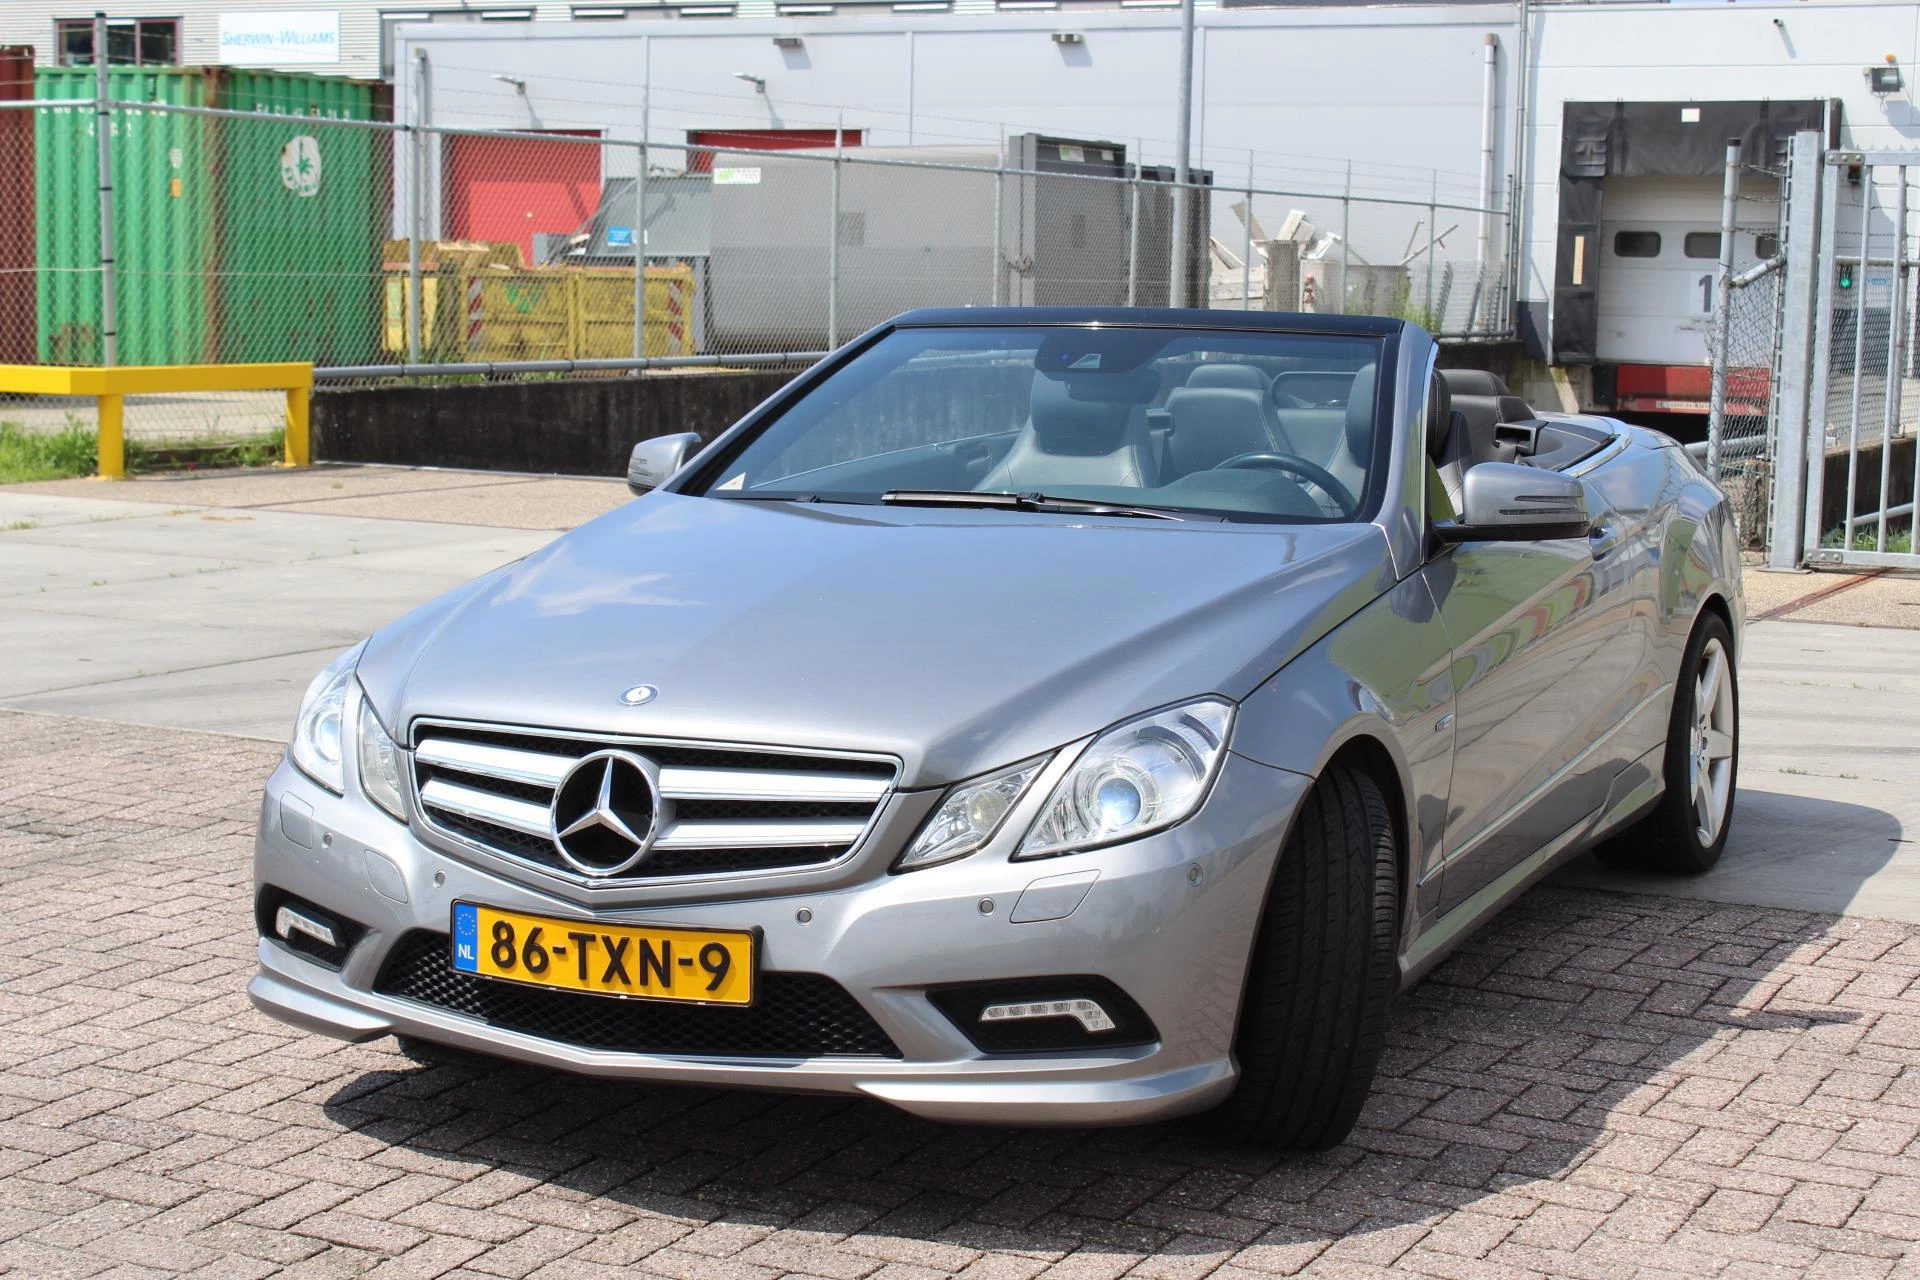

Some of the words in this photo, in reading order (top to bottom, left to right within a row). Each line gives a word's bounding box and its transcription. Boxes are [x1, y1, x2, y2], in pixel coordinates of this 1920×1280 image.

[1698, 274, 1713, 313] 1
[458, 943, 475, 960] NL
[491, 920, 731, 991] 86-TXN-9
